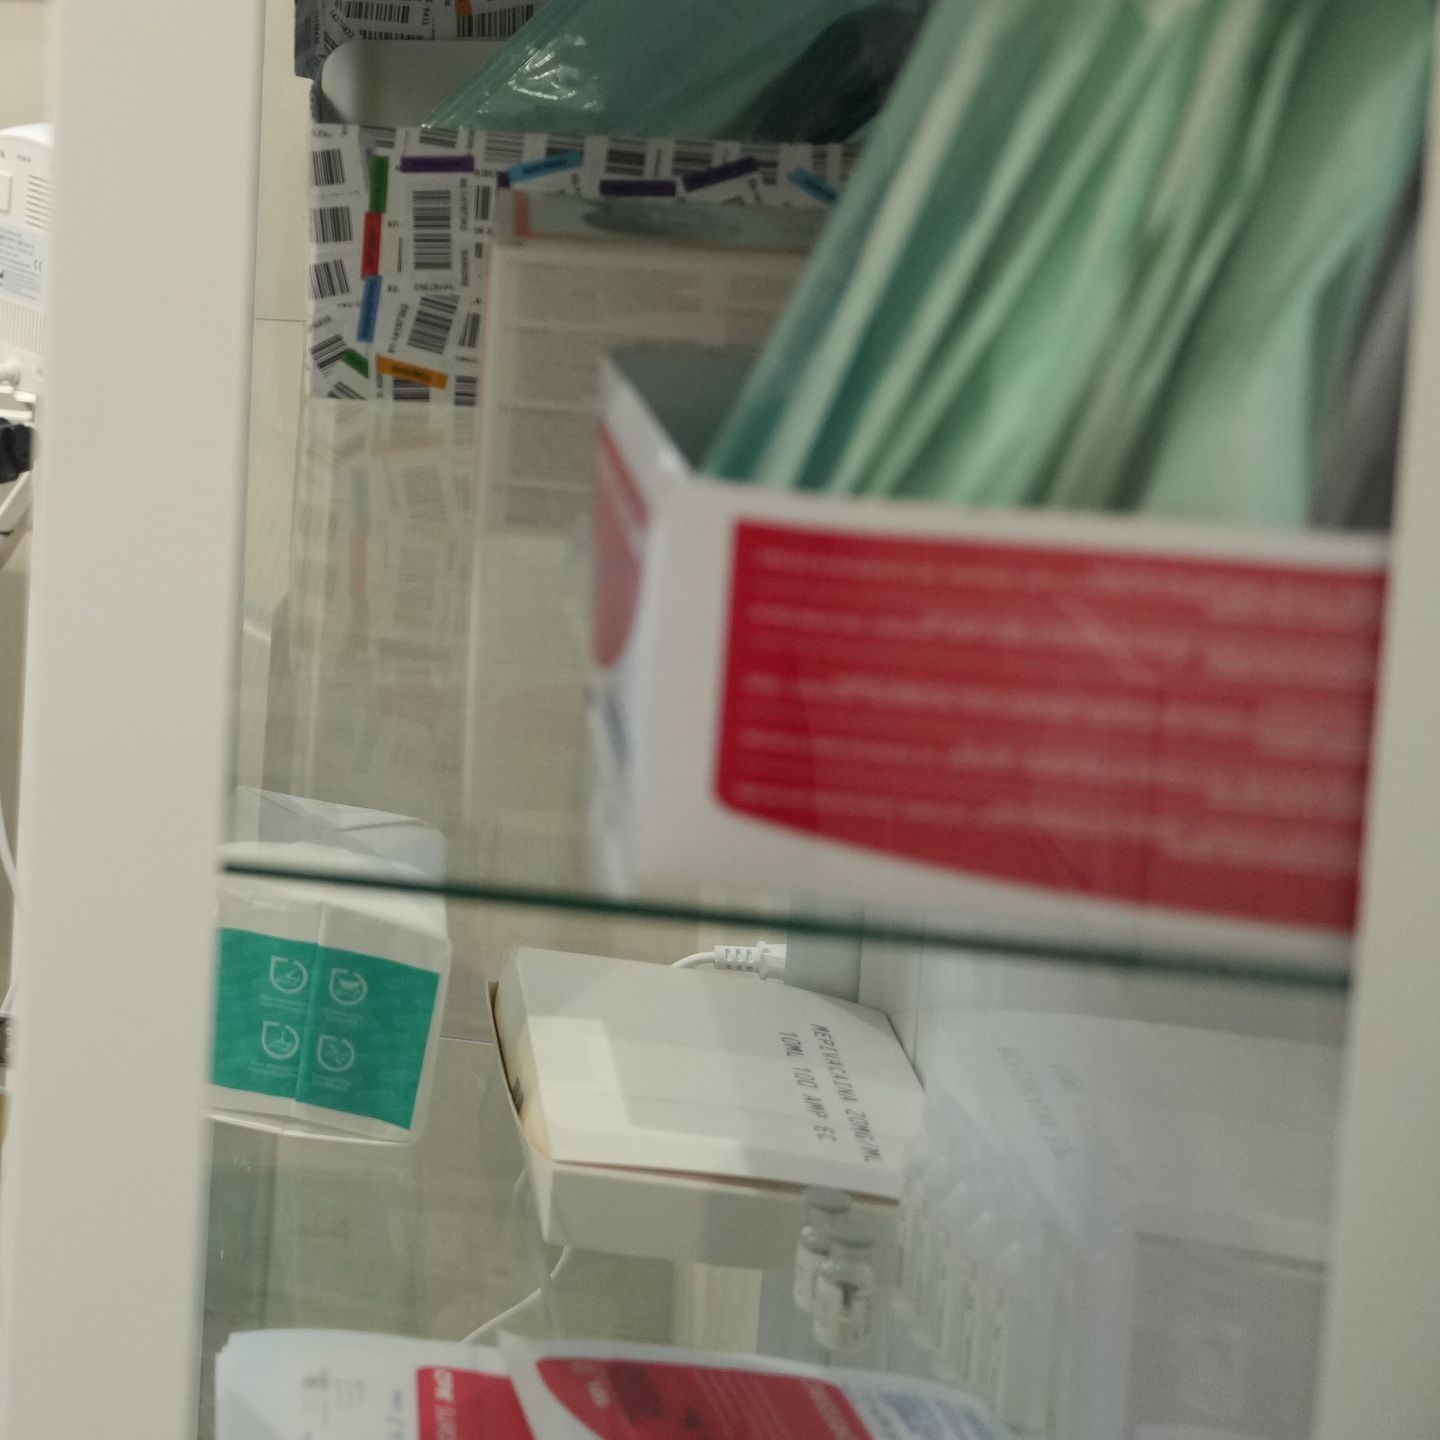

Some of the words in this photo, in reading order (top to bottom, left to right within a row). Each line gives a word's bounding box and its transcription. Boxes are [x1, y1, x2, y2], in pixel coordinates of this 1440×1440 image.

[778, 1031, 804, 1058] 10ML
[792, 1066, 818, 1090] 100
[802, 1093, 828, 1120] AMP
[810, 1023, 858, 1103] MEPIVACAINA
[844, 1108, 882, 1163] 20MG/ML
